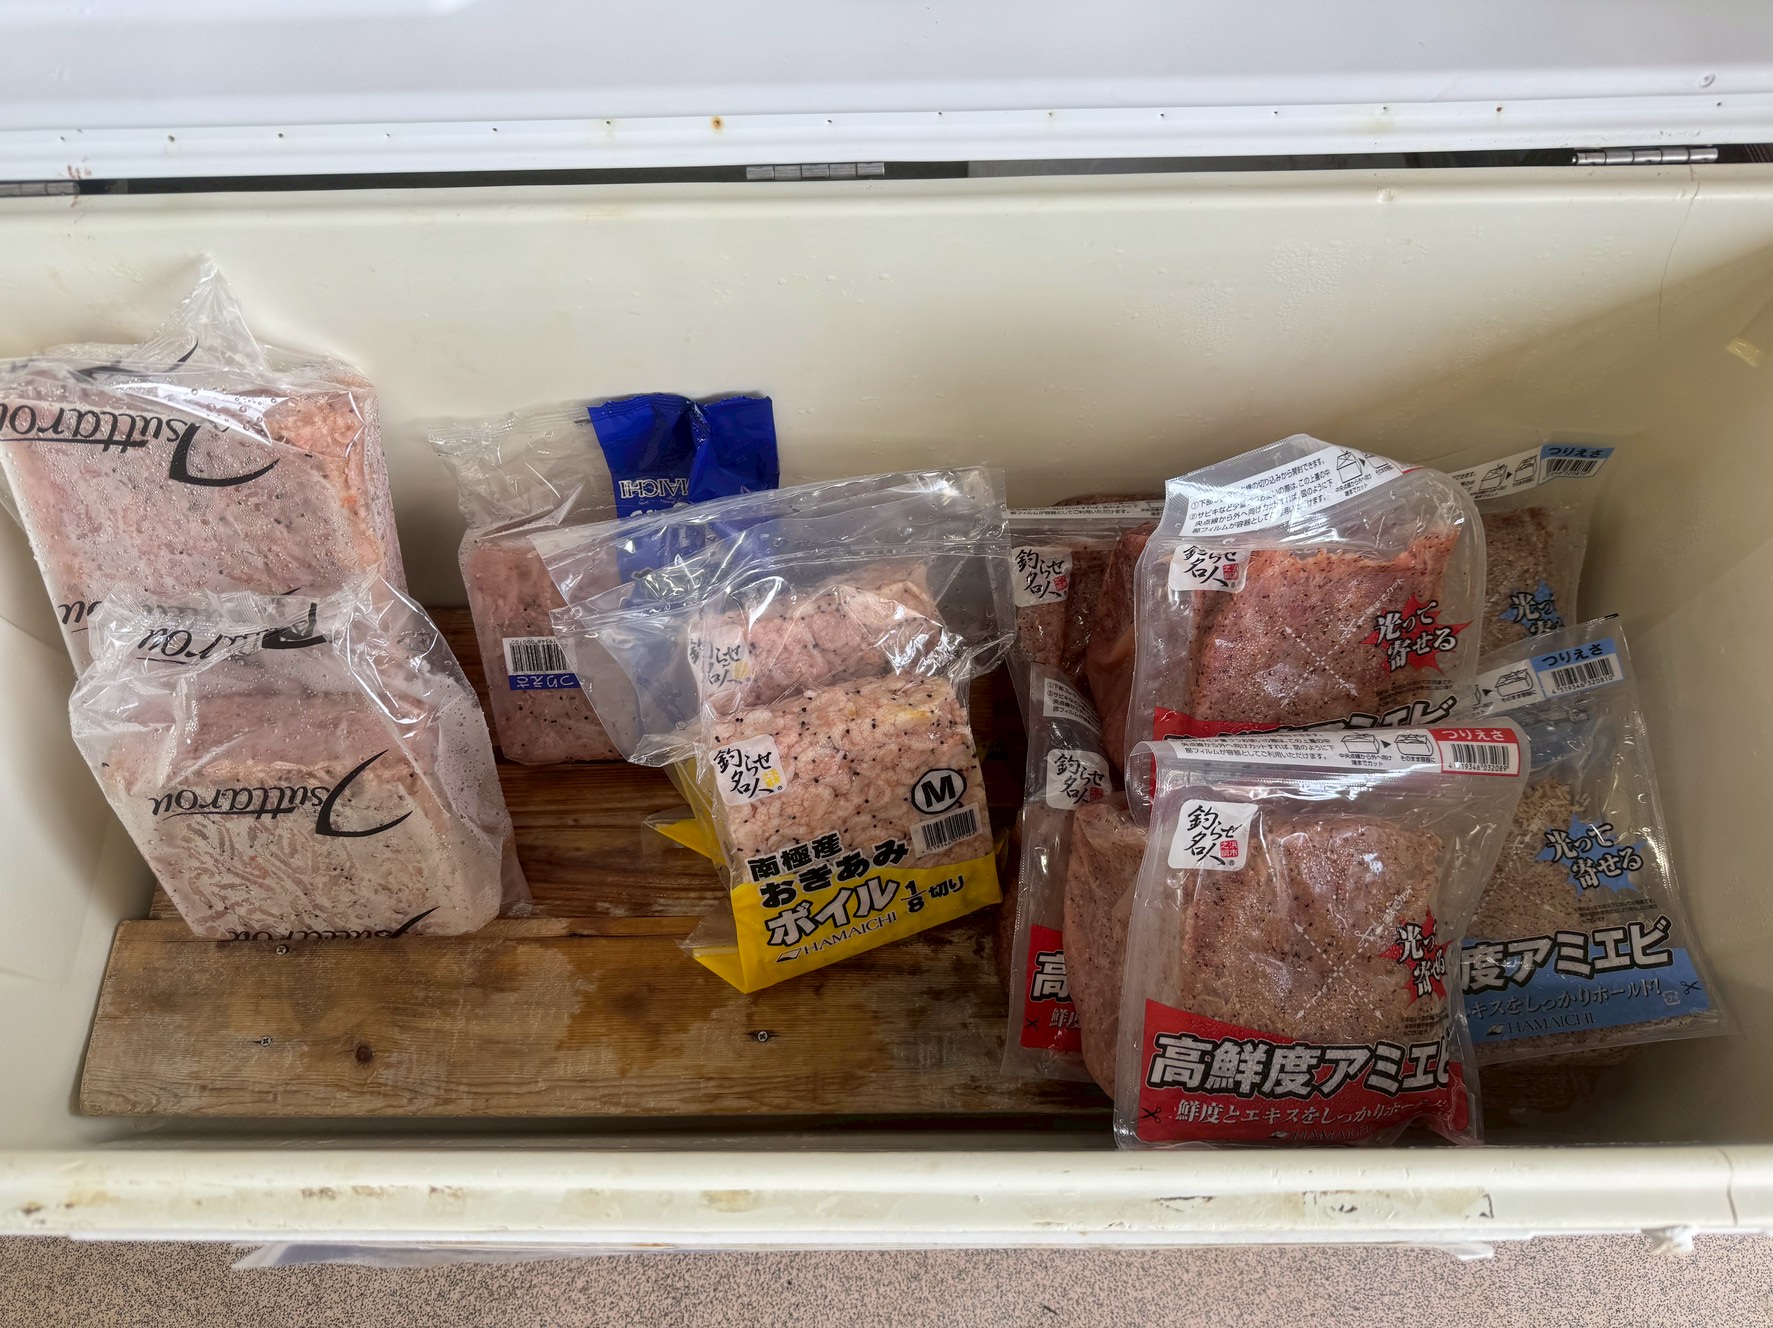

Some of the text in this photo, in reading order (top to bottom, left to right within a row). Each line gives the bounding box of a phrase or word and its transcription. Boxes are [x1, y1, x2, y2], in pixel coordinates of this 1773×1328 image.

[1549, 447, 1604, 458] つりえさ
[1374, 600, 1438, 648] 光って
[1509, 592, 1555, 623] 光っ
[1387, 626, 1458, 673] 寄せる
[1542, 643, 1604, 666] つりえさ
[516, 675, 574, 688] つりえさ
[1442, 729, 1505, 741] つりえさ
[713, 748, 772, 777] 釣らせ
[730, 770, 775, 799] 名人
[920, 774, 957, 809] M
[1187, 805, 1243, 841] 釣らせ
[747, 832, 843, 882] 南極産
[1184, 831, 1226, 866] 名人
[1544, 822, 1615, 862] 光って
[760, 839, 910, 908] おきあみ
[1571, 846, 1644, 890] 寄せる
[765, 875, 900, 947] ボイル
[803, 912, 898, 955] HAMAICHI
[1395, 919, 1437, 965] 光っ
[1468, 977, 1662, 1020] キスをしっかりホールド!
[1507, 1012, 1595, 1034] HAMAICHI
[1176, 1098, 1448, 1125] 鮮度とエキスをしっかりホー
